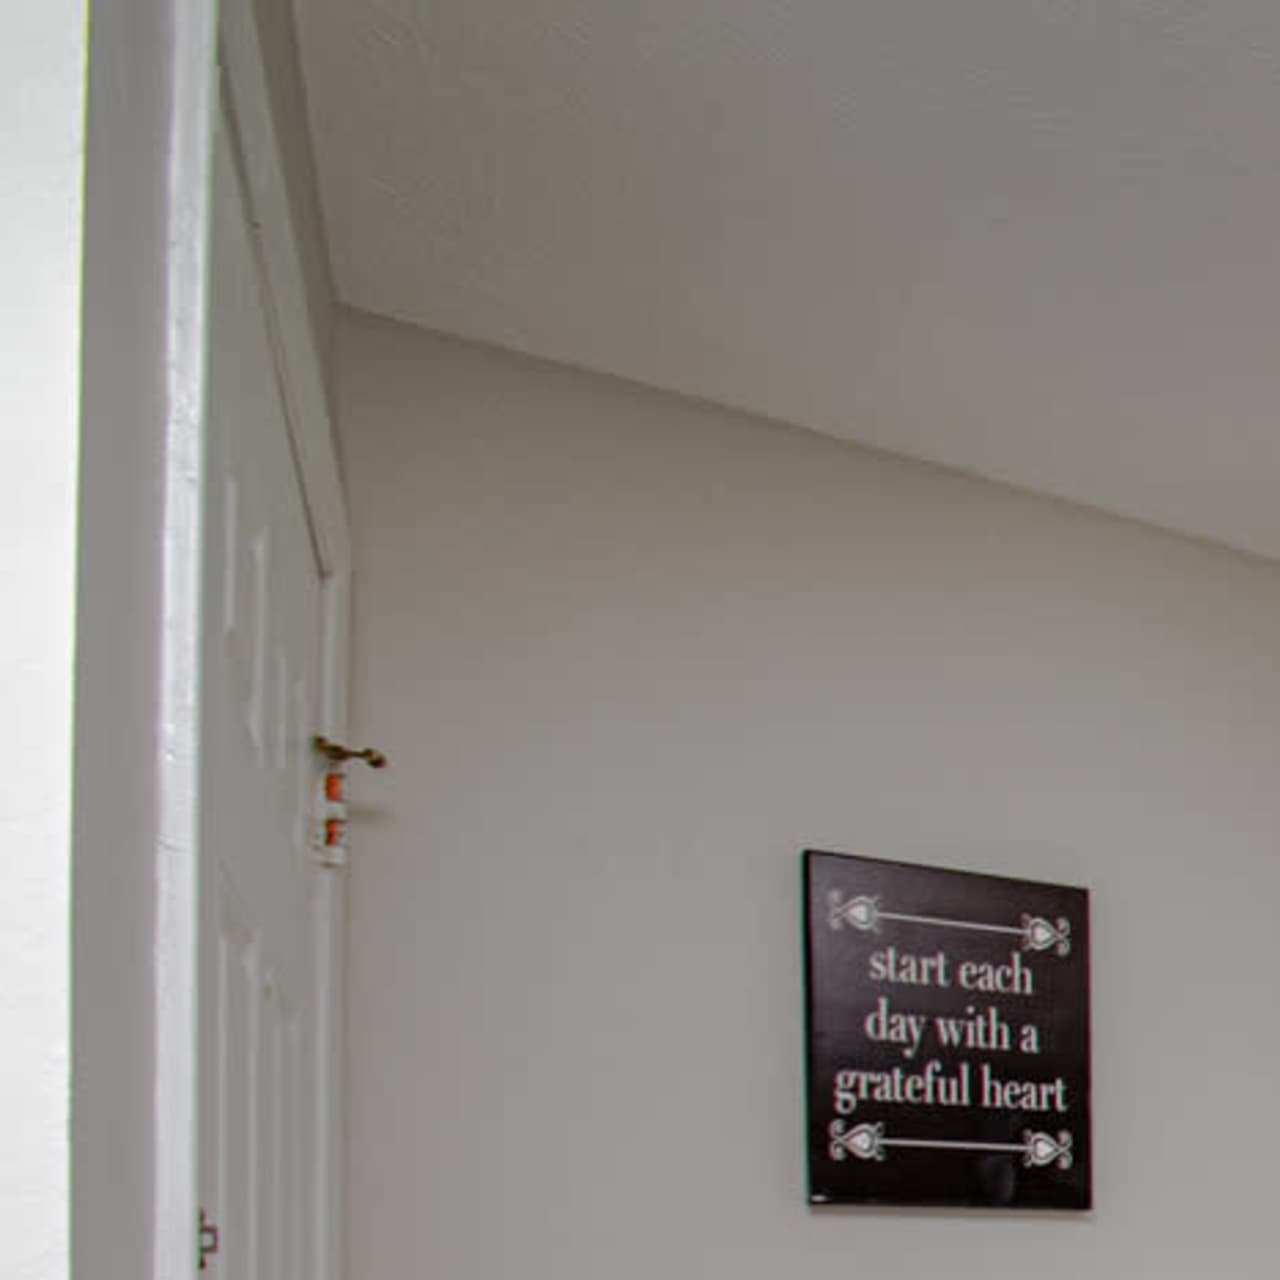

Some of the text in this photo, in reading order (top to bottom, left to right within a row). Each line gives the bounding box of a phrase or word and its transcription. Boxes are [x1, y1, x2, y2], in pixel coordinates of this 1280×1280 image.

[868, 946, 1033, 994] start each
[865, 997, 1040, 1057] day with a
[833, 1061, 1067, 1114] grateful heart
